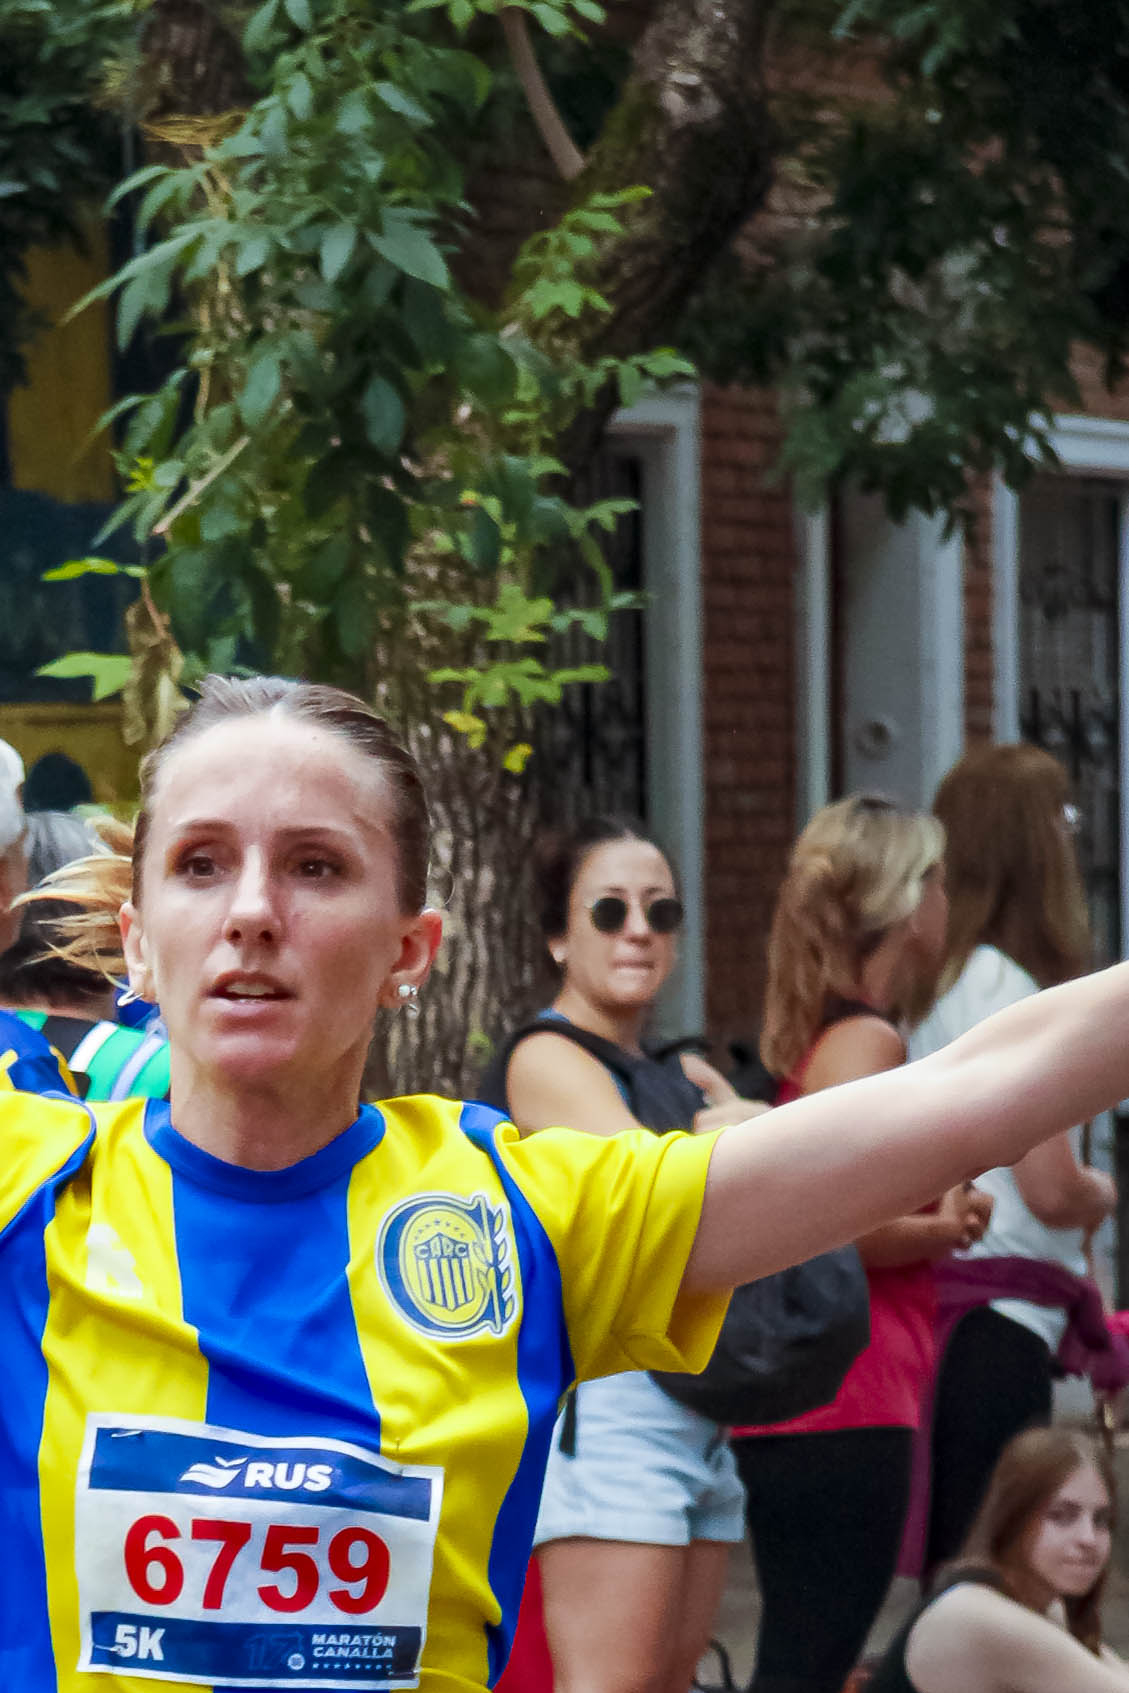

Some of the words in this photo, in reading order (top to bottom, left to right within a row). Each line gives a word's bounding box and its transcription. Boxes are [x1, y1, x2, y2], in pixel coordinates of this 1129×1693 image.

[243, 1462, 333, 1491] RUS
[123, 1514, 391, 1615] 6759
[114, 1624, 165, 1661] 5K
[312, 1632, 397, 1647] MARATÓN
[312, 1646, 394, 1660] CANALLA
